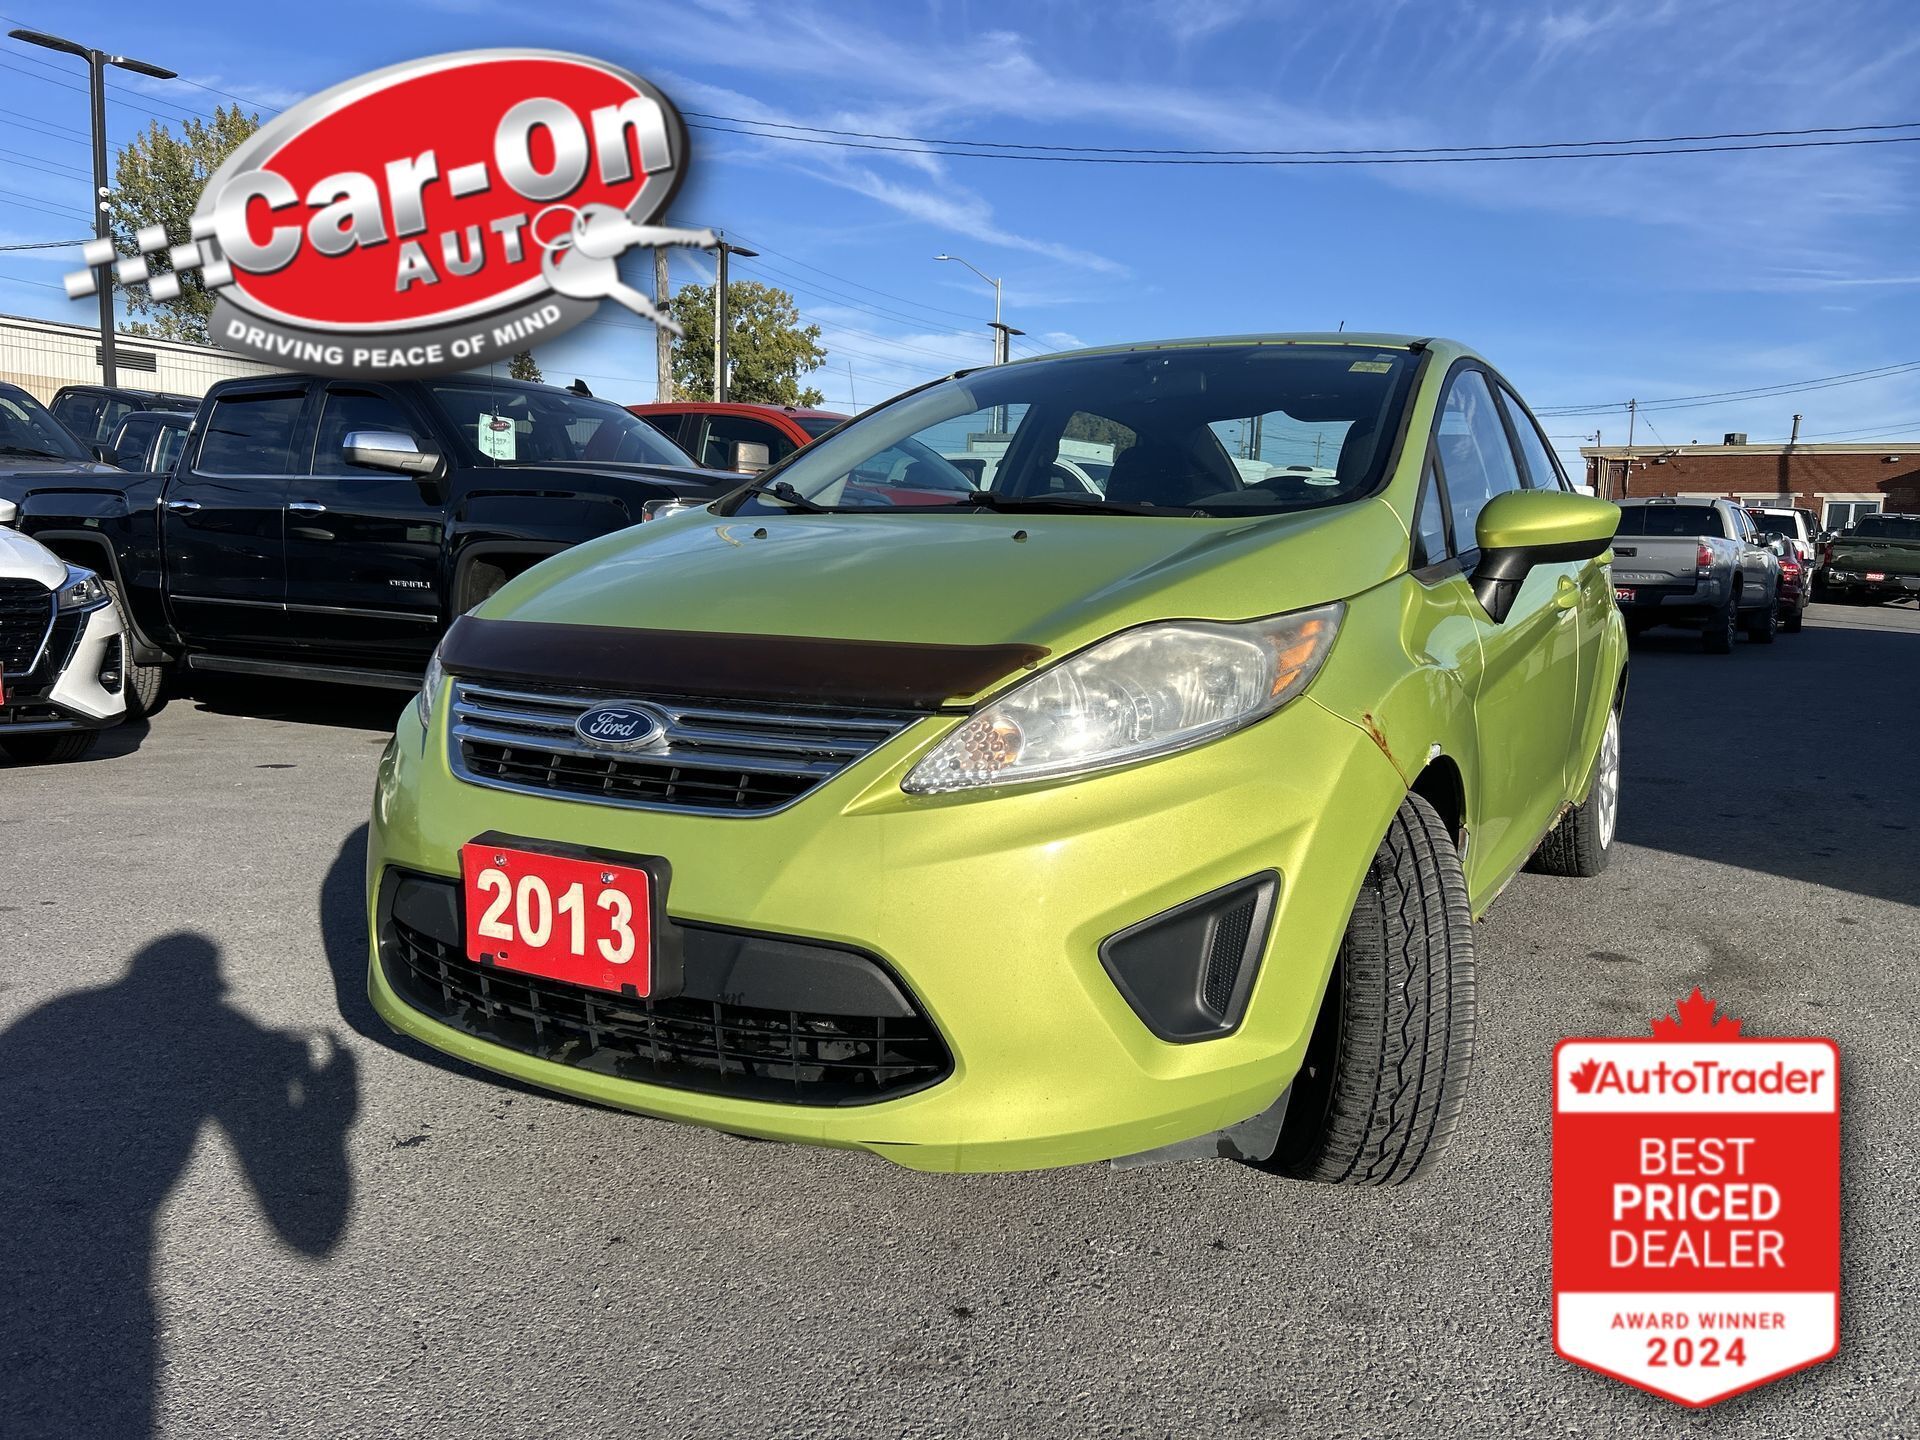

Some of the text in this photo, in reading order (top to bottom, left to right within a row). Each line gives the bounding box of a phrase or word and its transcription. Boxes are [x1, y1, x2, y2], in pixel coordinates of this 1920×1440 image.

[1615, 592, 1635, 601] 021
[589, 712, 636, 737] Ford
[477, 868, 636, 965] 2013
